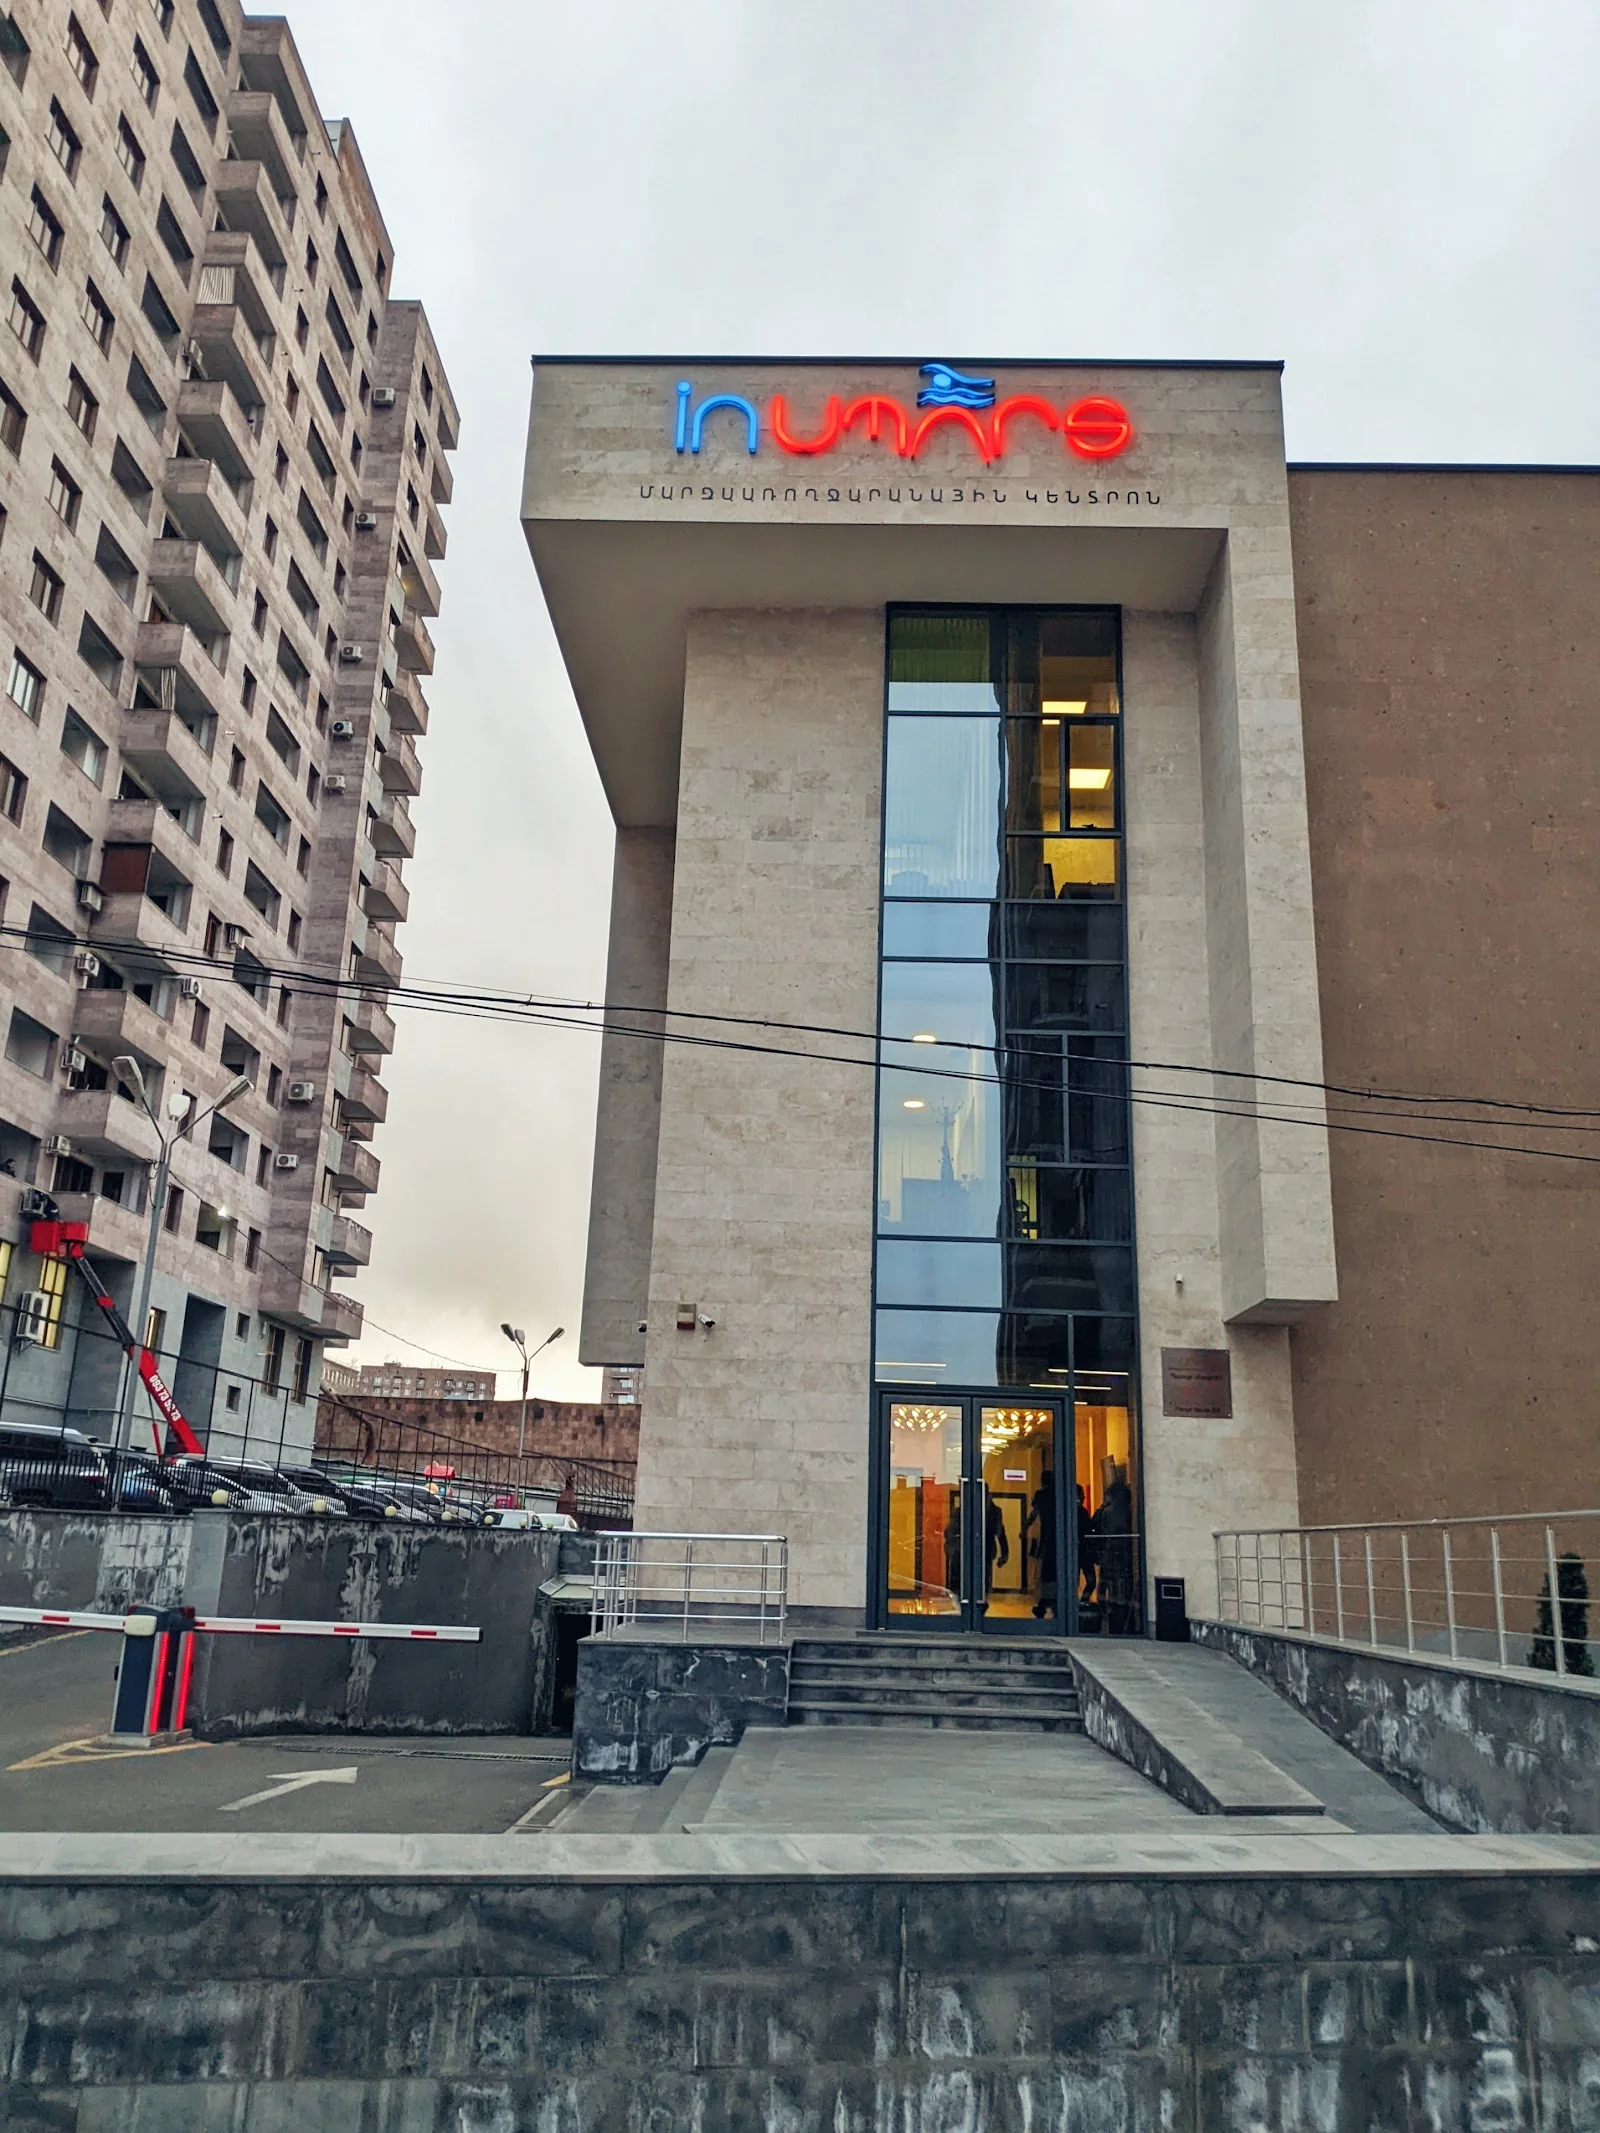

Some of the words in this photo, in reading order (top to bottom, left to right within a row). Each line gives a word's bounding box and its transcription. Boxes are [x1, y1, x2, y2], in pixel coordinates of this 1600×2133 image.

[639, 485, 1007, 504] ՄԱՐԶԱԱՌՈՂՋԱՐԱՆԱՅԻՆ
[1025, 489, 1161, 505] ԿԵՆՏՐՈՆ
[149, 1374, 164, 1392] 093
[158, 1388, 170, 1402] 73
[170, 1408, 182, 1422] 73
